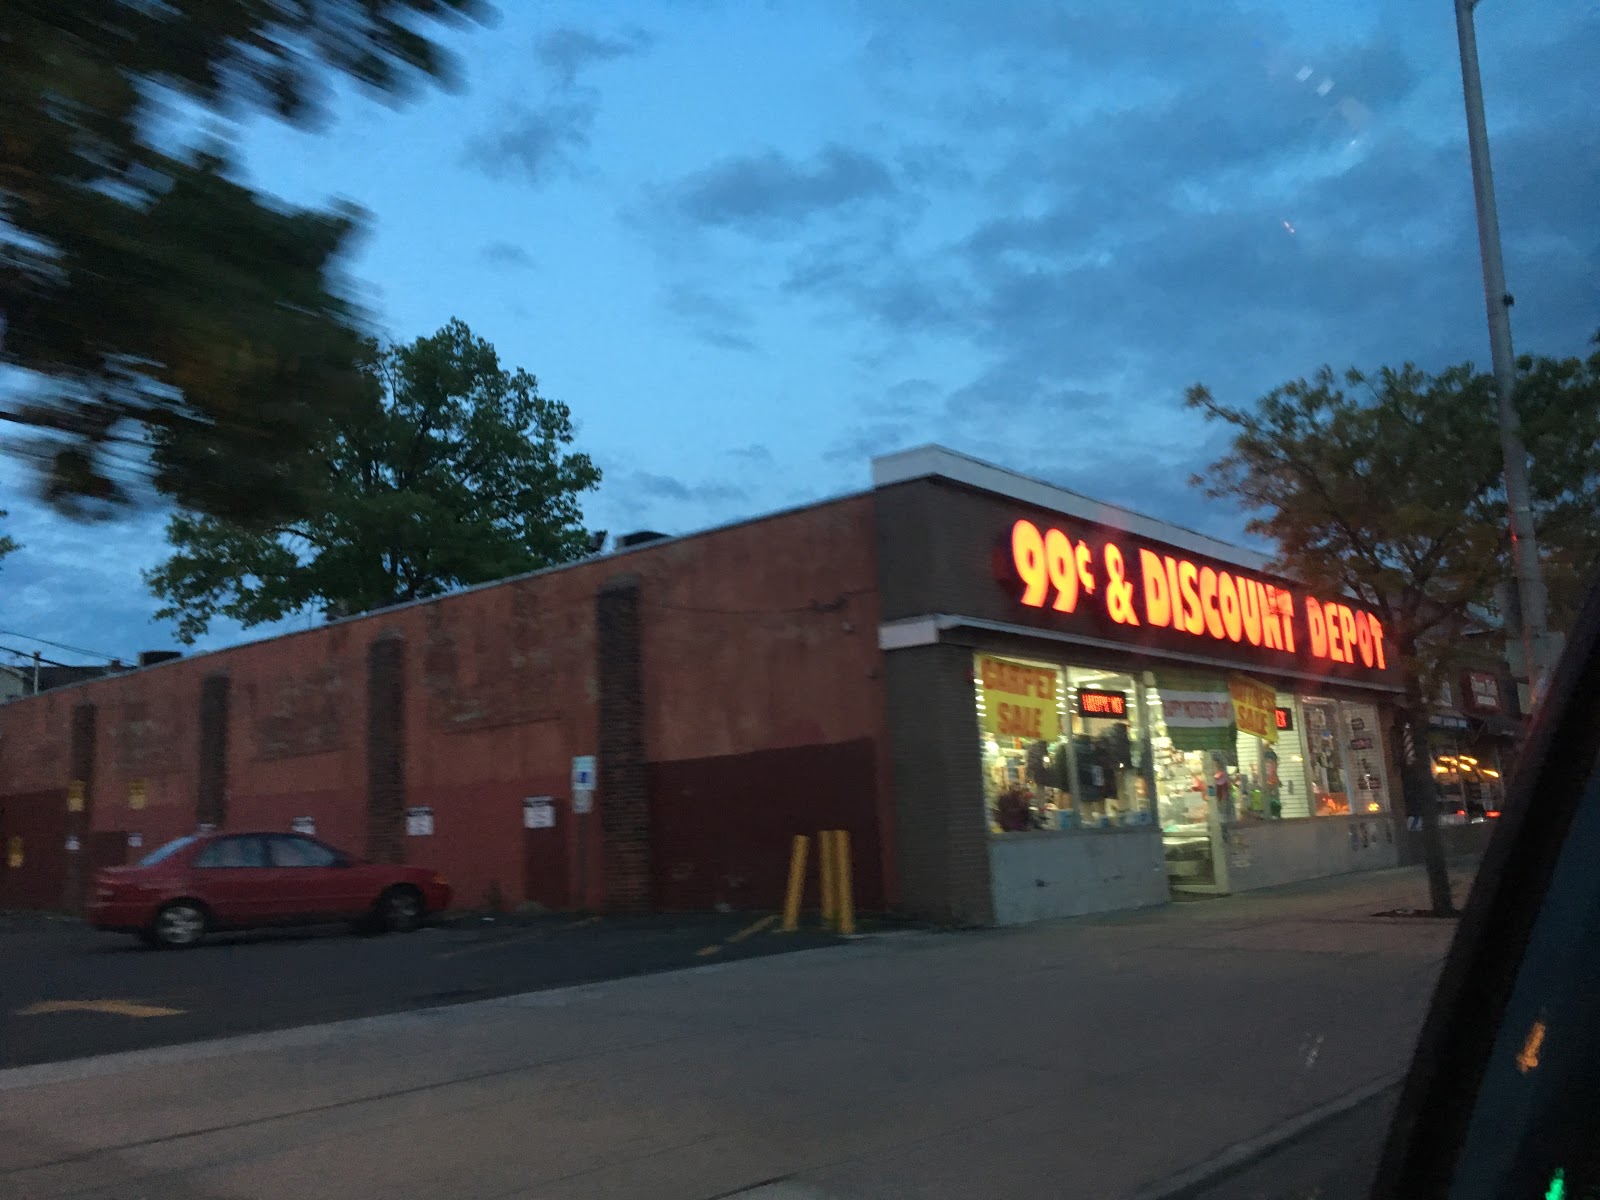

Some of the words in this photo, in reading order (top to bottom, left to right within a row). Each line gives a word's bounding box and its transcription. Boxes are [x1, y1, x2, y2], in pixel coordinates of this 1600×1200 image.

[1104, 542, 1140, 626] &
[1139, 548, 1296, 653] DISCOUNT
[1305, 596, 1387, 670] DEPOT
[998, 702, 1041, 738] SALE
[1237, 705, 1268, 736] SALE
